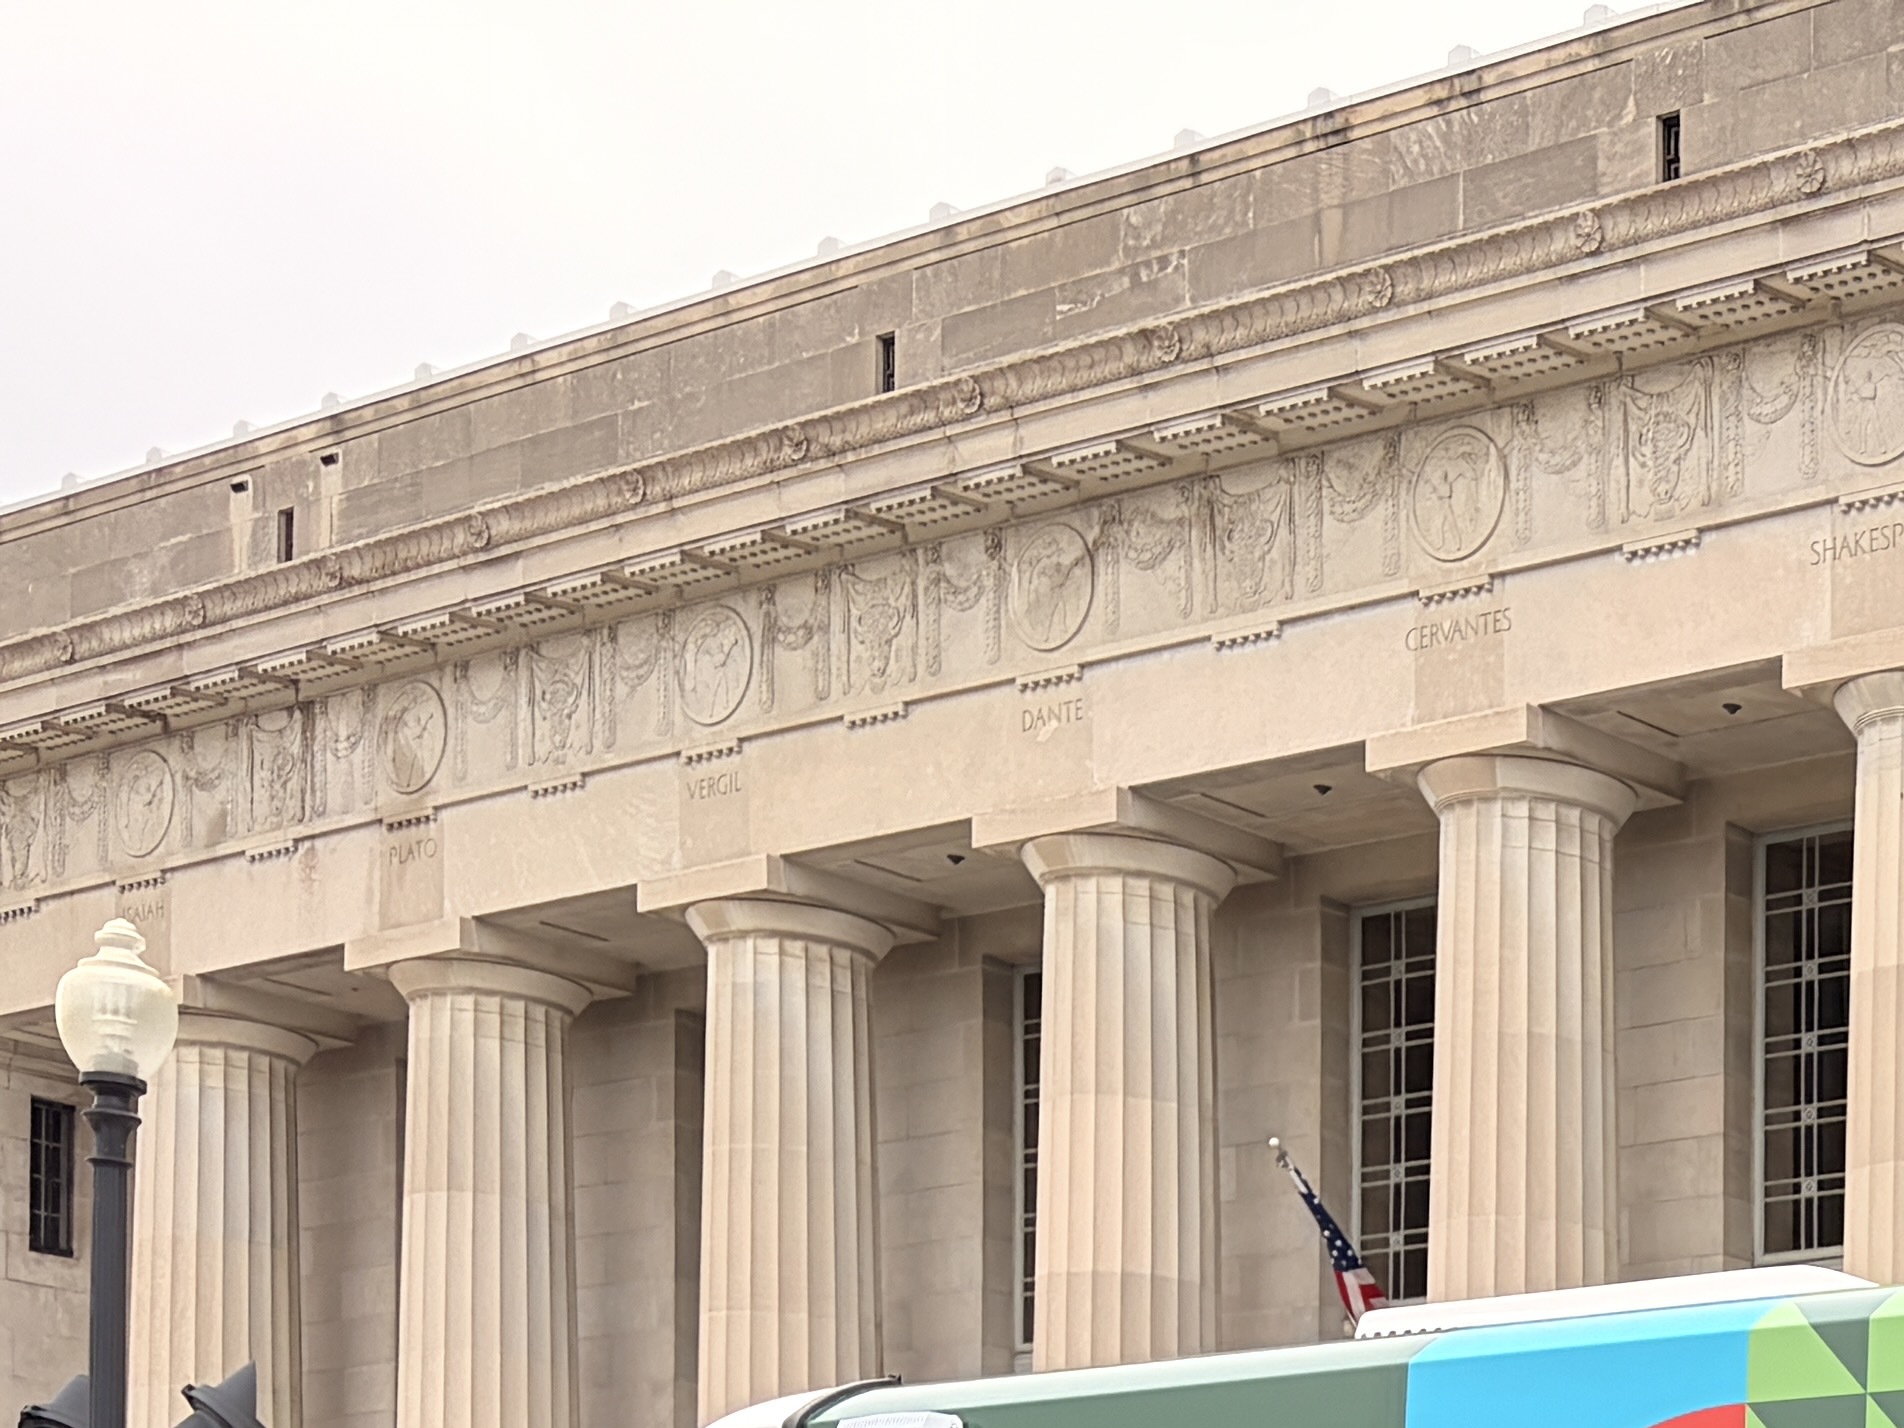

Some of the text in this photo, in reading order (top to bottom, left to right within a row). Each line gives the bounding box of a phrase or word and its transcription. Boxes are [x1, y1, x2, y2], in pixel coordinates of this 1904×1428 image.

[1405, 606, 1512, 651] CERVANTES
[1022, 698, 1083, 733] DANTE
[686, 771, 742, 800] VERGIL
[388, 837, 437, 867] PLATO
